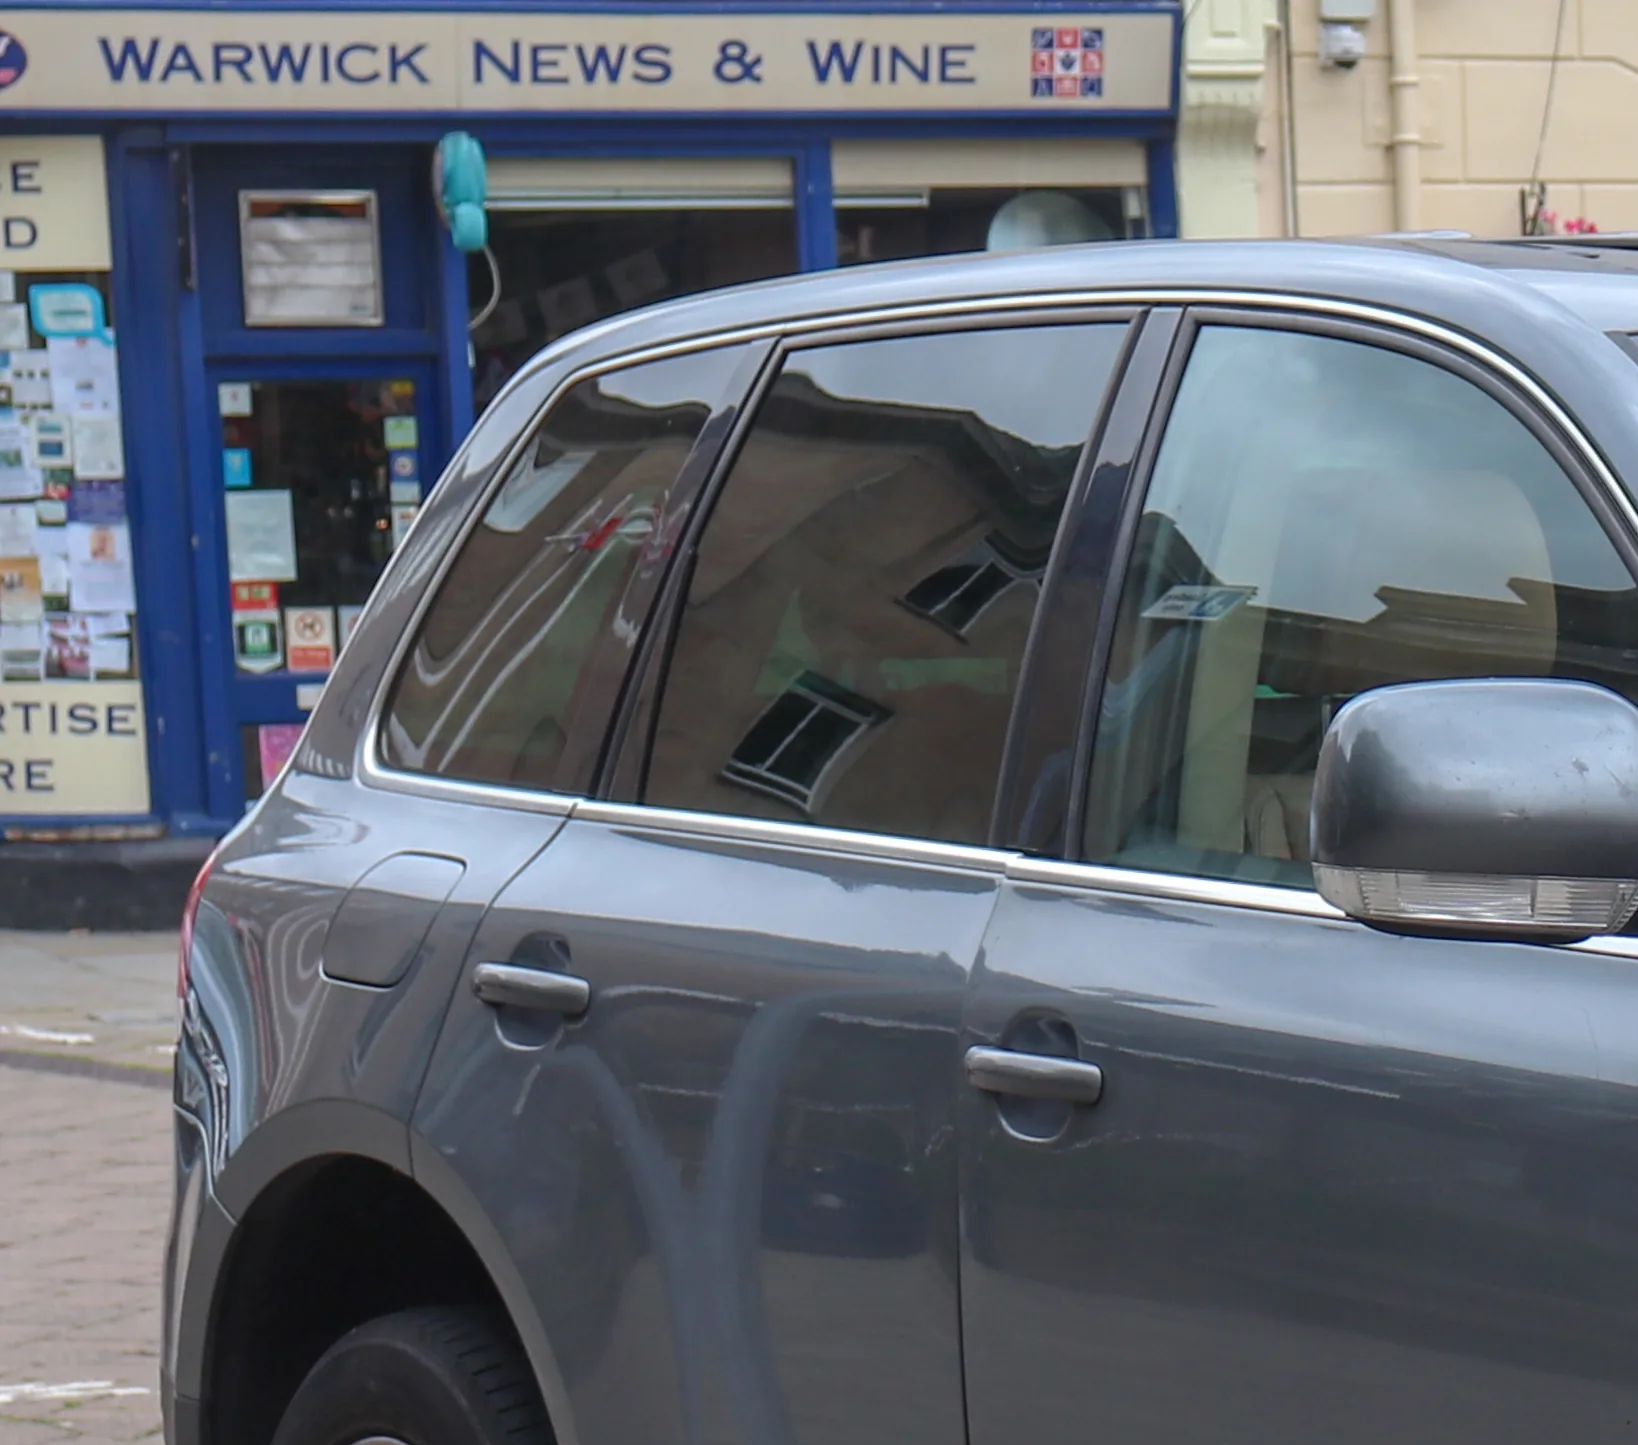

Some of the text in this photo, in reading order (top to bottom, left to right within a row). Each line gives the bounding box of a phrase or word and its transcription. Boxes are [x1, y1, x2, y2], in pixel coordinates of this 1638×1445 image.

[98, 37, 976, 85] WARWICK NEWS & WINE
[0, 160, 42, 194] E
